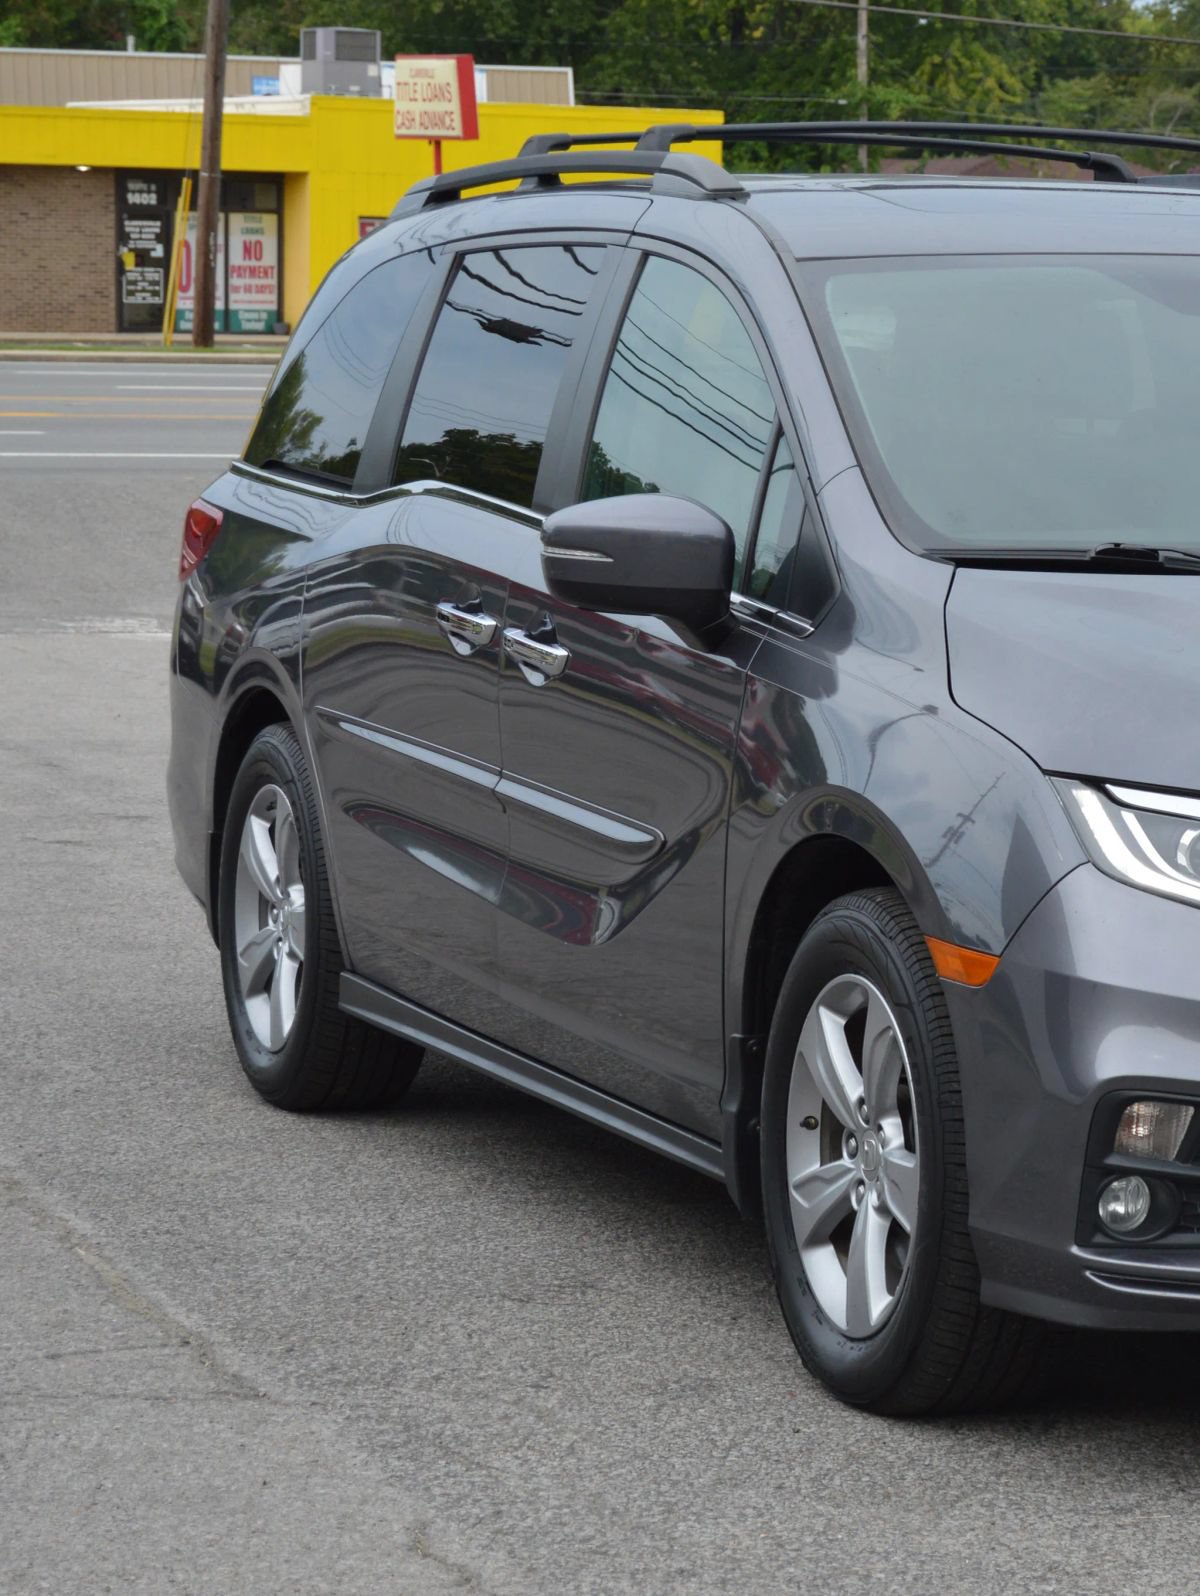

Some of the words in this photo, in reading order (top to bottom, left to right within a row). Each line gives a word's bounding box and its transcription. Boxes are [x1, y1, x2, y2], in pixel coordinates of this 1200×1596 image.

[396, 82, 418, 102] TITLE
[421, 82, 452, 103] LOANS
[396, 110, 416, 130] CASH
[420, 110, 455, 131] ADVANCE
[126, 192, 158, 205] 1402
[243, 240, 263, 262] NO
[229, 265, 275, 279] PAYMENT
